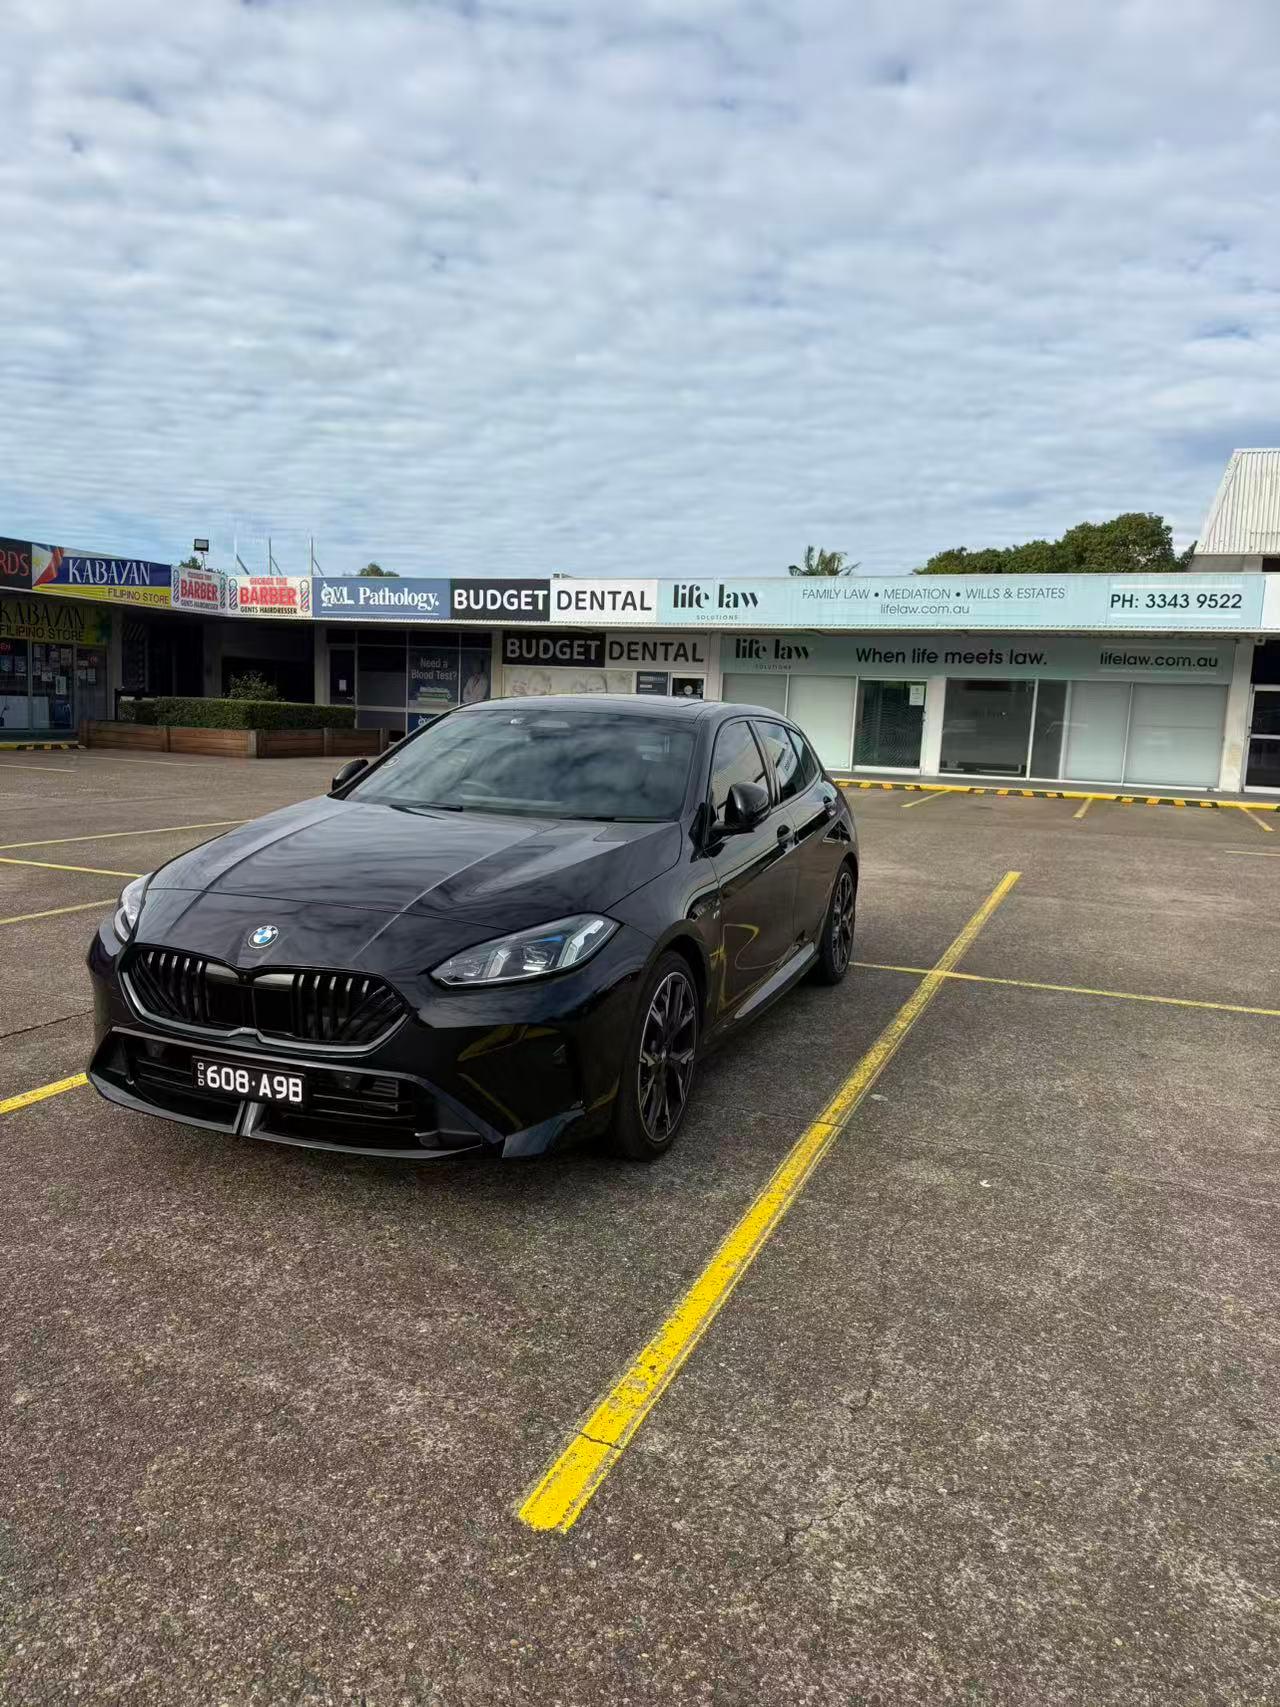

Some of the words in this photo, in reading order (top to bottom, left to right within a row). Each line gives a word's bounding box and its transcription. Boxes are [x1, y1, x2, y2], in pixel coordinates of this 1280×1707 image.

[69, 558, 150, 585] KABAYAN
[107, 588, 141, 601] FILIPINO
[143, 592, 169, 605] STORE
[181, 578, 218, 602] BARBER
[240, 587, 296, 606] BARBER
[359, 586, 439, 610] Pathology.
[673, 584, 709, 608] life
[718, 584, 758, 608] law
[802, 588, 841, 600] FAMILY
[844, 588, 870, 600] LAW
[884, 588, 950, 600] MEDIATION
[966, 588, 1000, 599] WILLS
[1003, 588, 1013, 599] &
[1017, 587, 1065, 599] ESTATES
[454, 589, 547, 610] BUDGET
[556, 590, 652, 611] DENTAL
[880, 602, 970, 615] lifelaw.com.au
[1110, 594, 1139, 609] PH:
[1145, 593, 1189, 609] 3343
[1196, 593, 1242, 610] 9522
[0, 600, 84, 630] KABAYAN
[260, 606, 297, 614] HAIRDRESSER
[0, 623, 47, 639] FILIPINO
[48, 627, 84, 641] STORE
[506, 639, 600, 660] BUDGET
[609, 640, 704, 663] DENTAL
[735, 638, 768, 659] life
[774, 639, 810, 660] law
[856, 648, 906, 664] When
[911, 647, 938, 664] life
[944, 649, 1003, 665] meets
[1009, 649, 1047, 665] law.
[420, 657, 441, 668] Need
[1100, 652, 1218, 667] lifelaw.com.au
[411, 669, 434, 679] Blood
[436, 670, 457, 680] Test?
[197, 1062, 205, 1086] QLD
